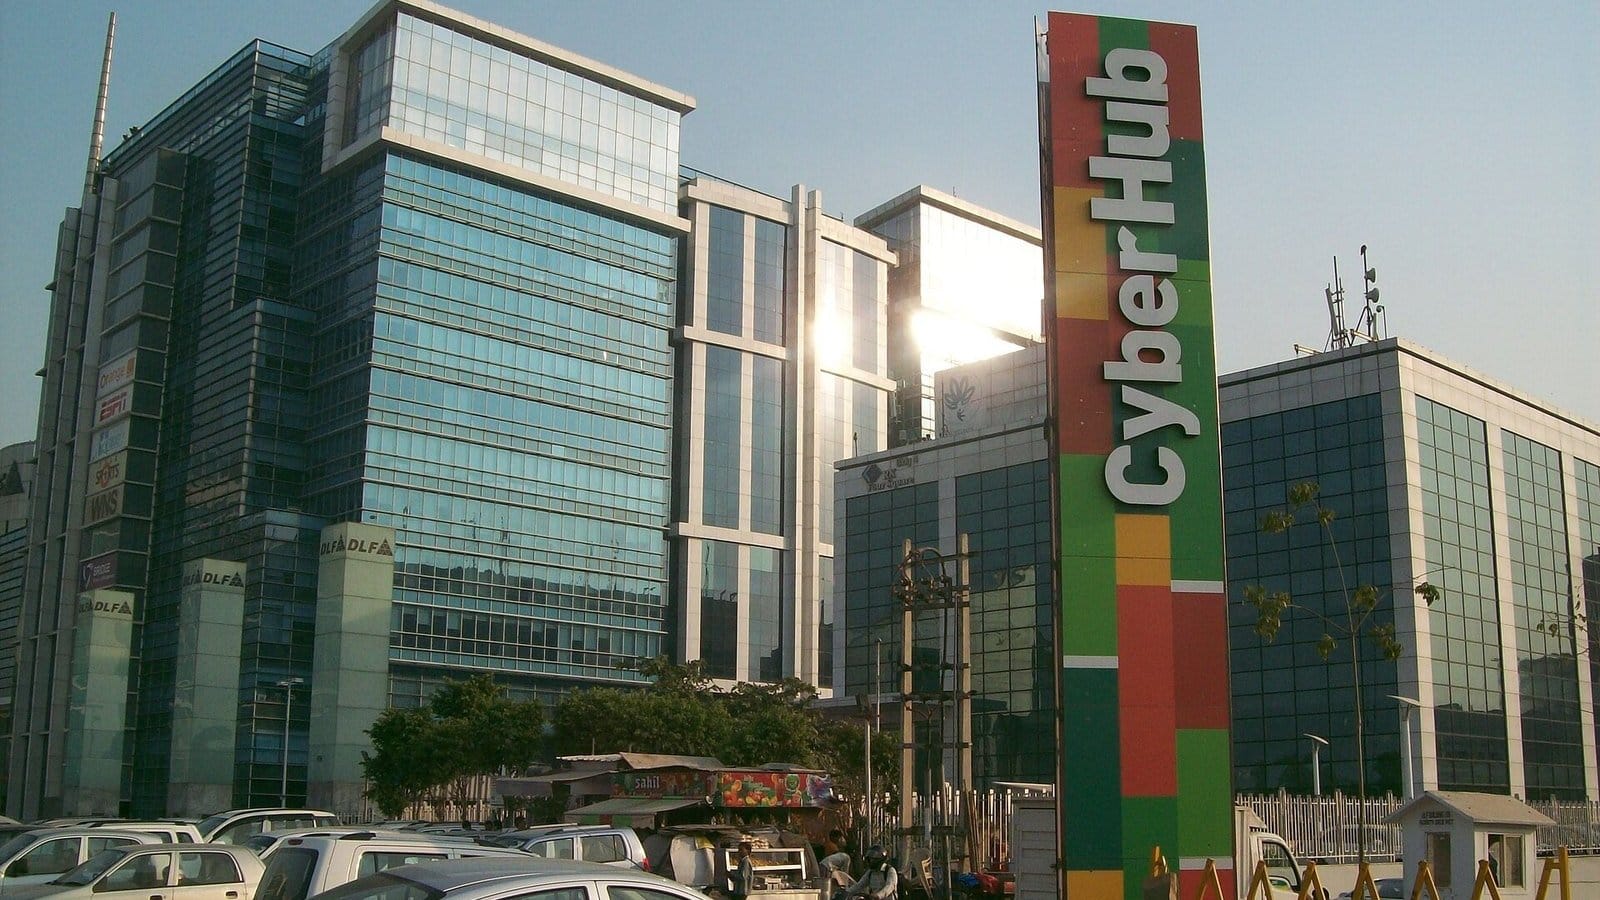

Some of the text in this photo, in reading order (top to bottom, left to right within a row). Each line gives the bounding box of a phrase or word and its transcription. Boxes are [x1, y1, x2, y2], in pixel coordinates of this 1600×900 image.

[1085, 48, 1201, 506] CyberHub
[320, 540, 338, 556] DLF
[347, 538, 379, 553] DLF
[203, 572, 231, 585] DLF
[94, 601, 120, 613] DLF
[635, 775, 660, 789] sahil
